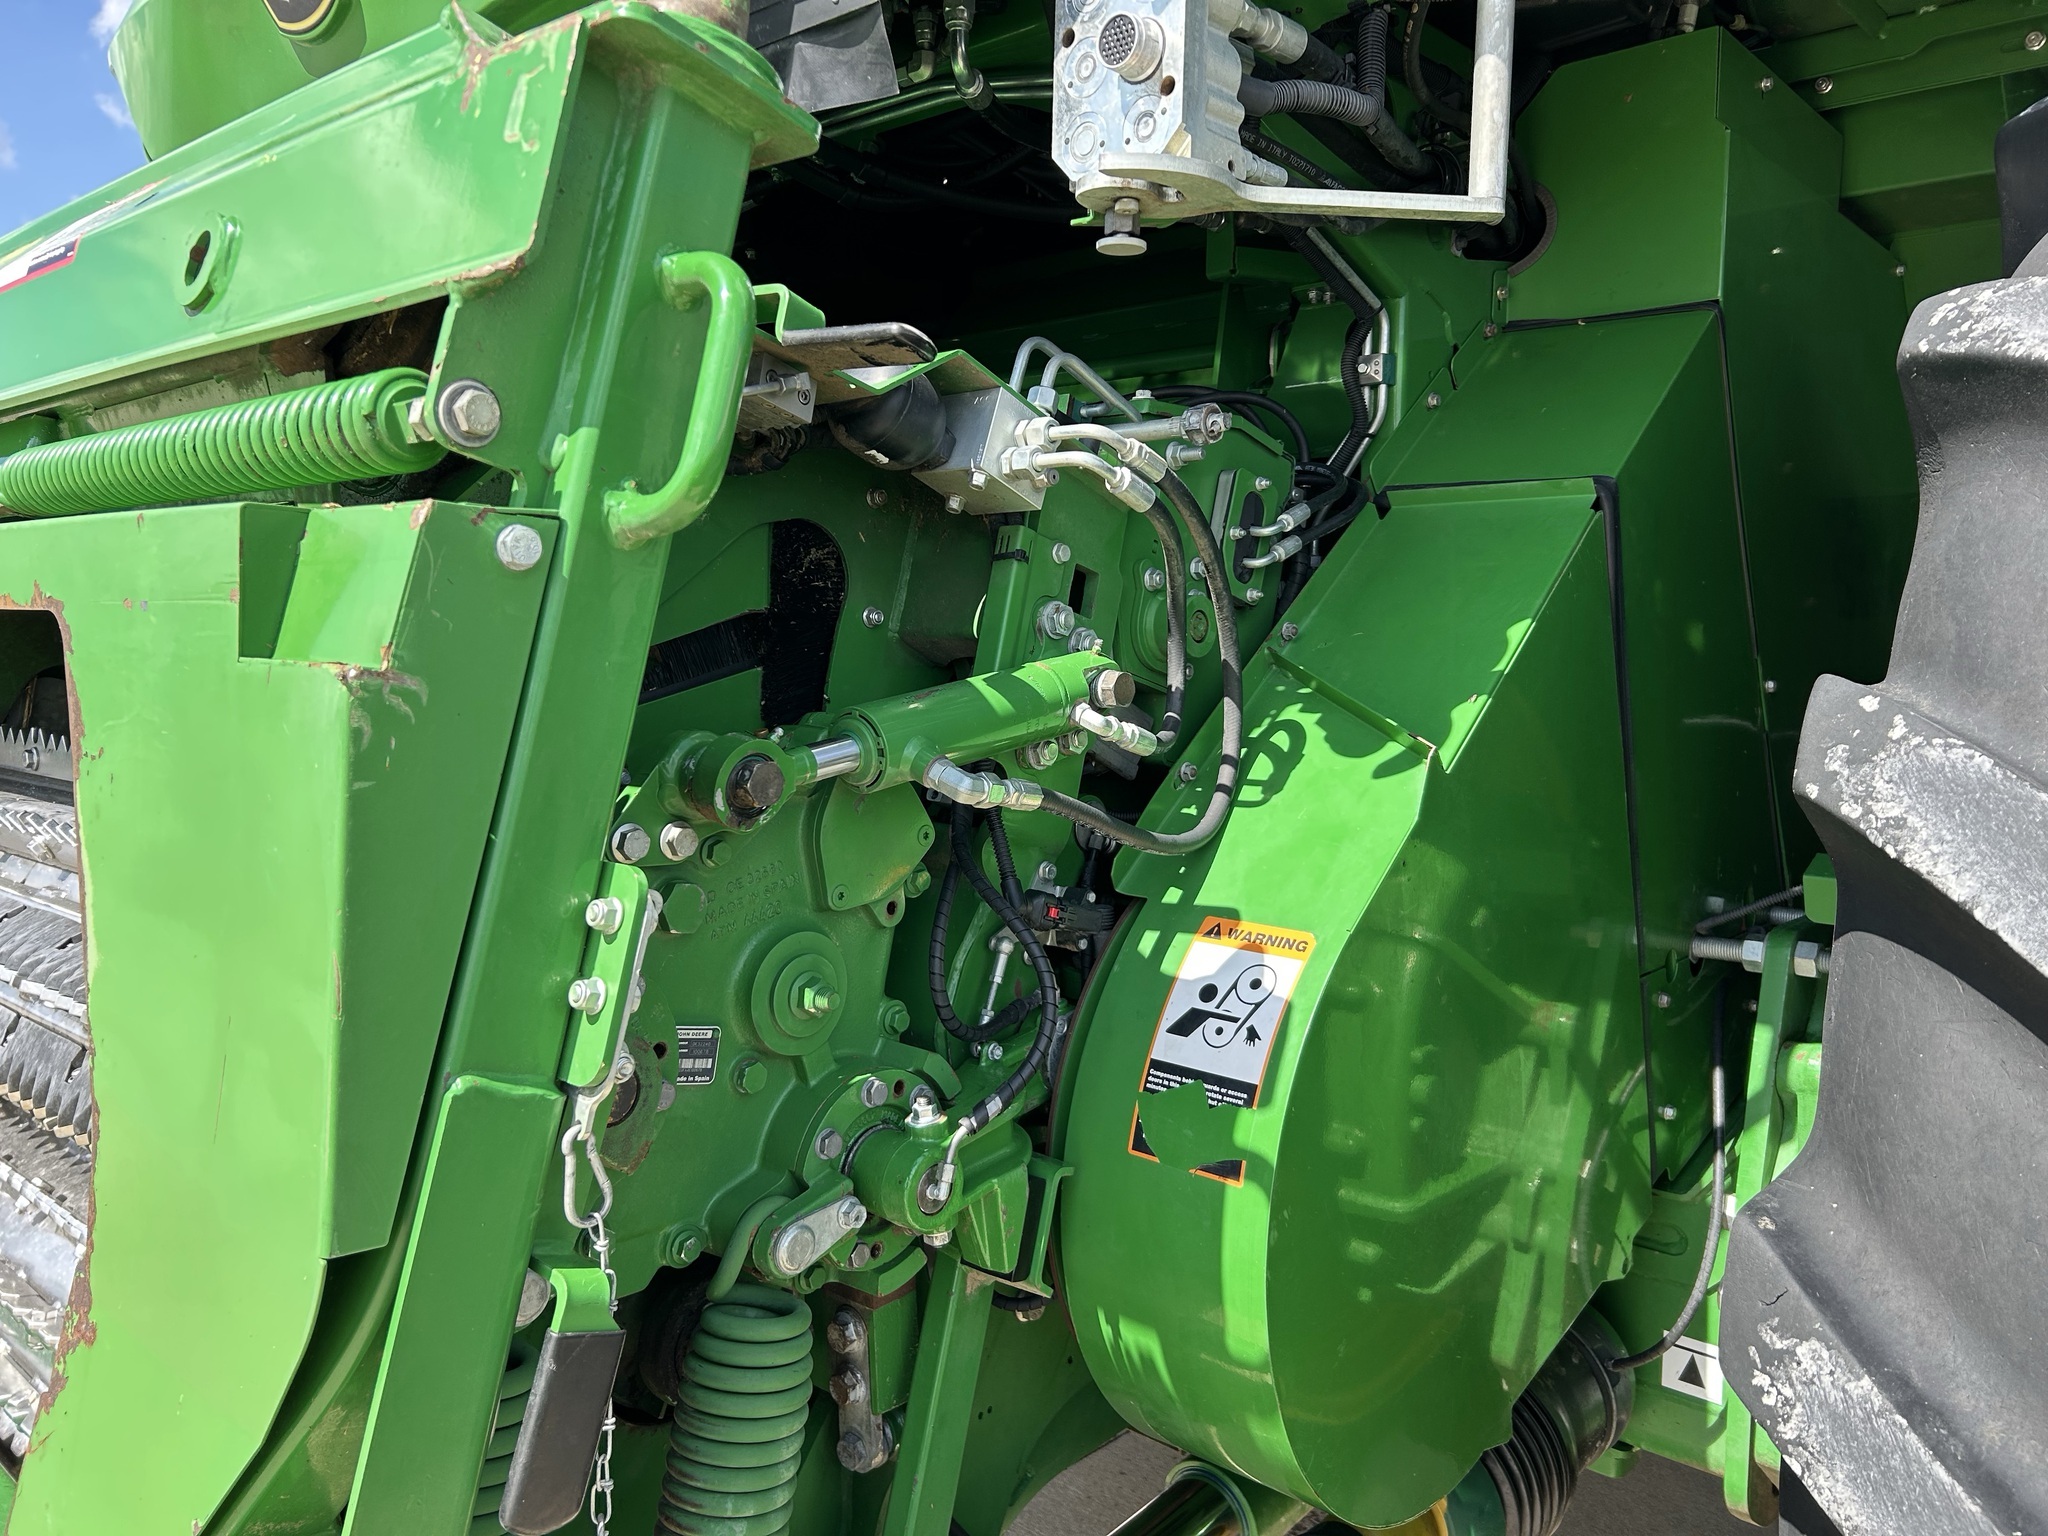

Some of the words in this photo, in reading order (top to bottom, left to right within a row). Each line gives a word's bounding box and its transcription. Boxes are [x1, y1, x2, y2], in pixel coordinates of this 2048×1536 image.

[1239, 128, 1257, 144] MADE
[1257, 138, 1267, 149] IN
[1268, 143, 1288, 159] ITALY
[763, 871, 802, 899] SPAIN
[1227, 927, 1309, 953] WARNING
[1147, 1076, 1163, 1084] doors
[1150, 1068, 1181, 1081] Components
[1206, 1091, 1223, 1100] rotate
[1223, 1096, 1244, 1105] several
[1228, 1089, 1248, 1099] access
